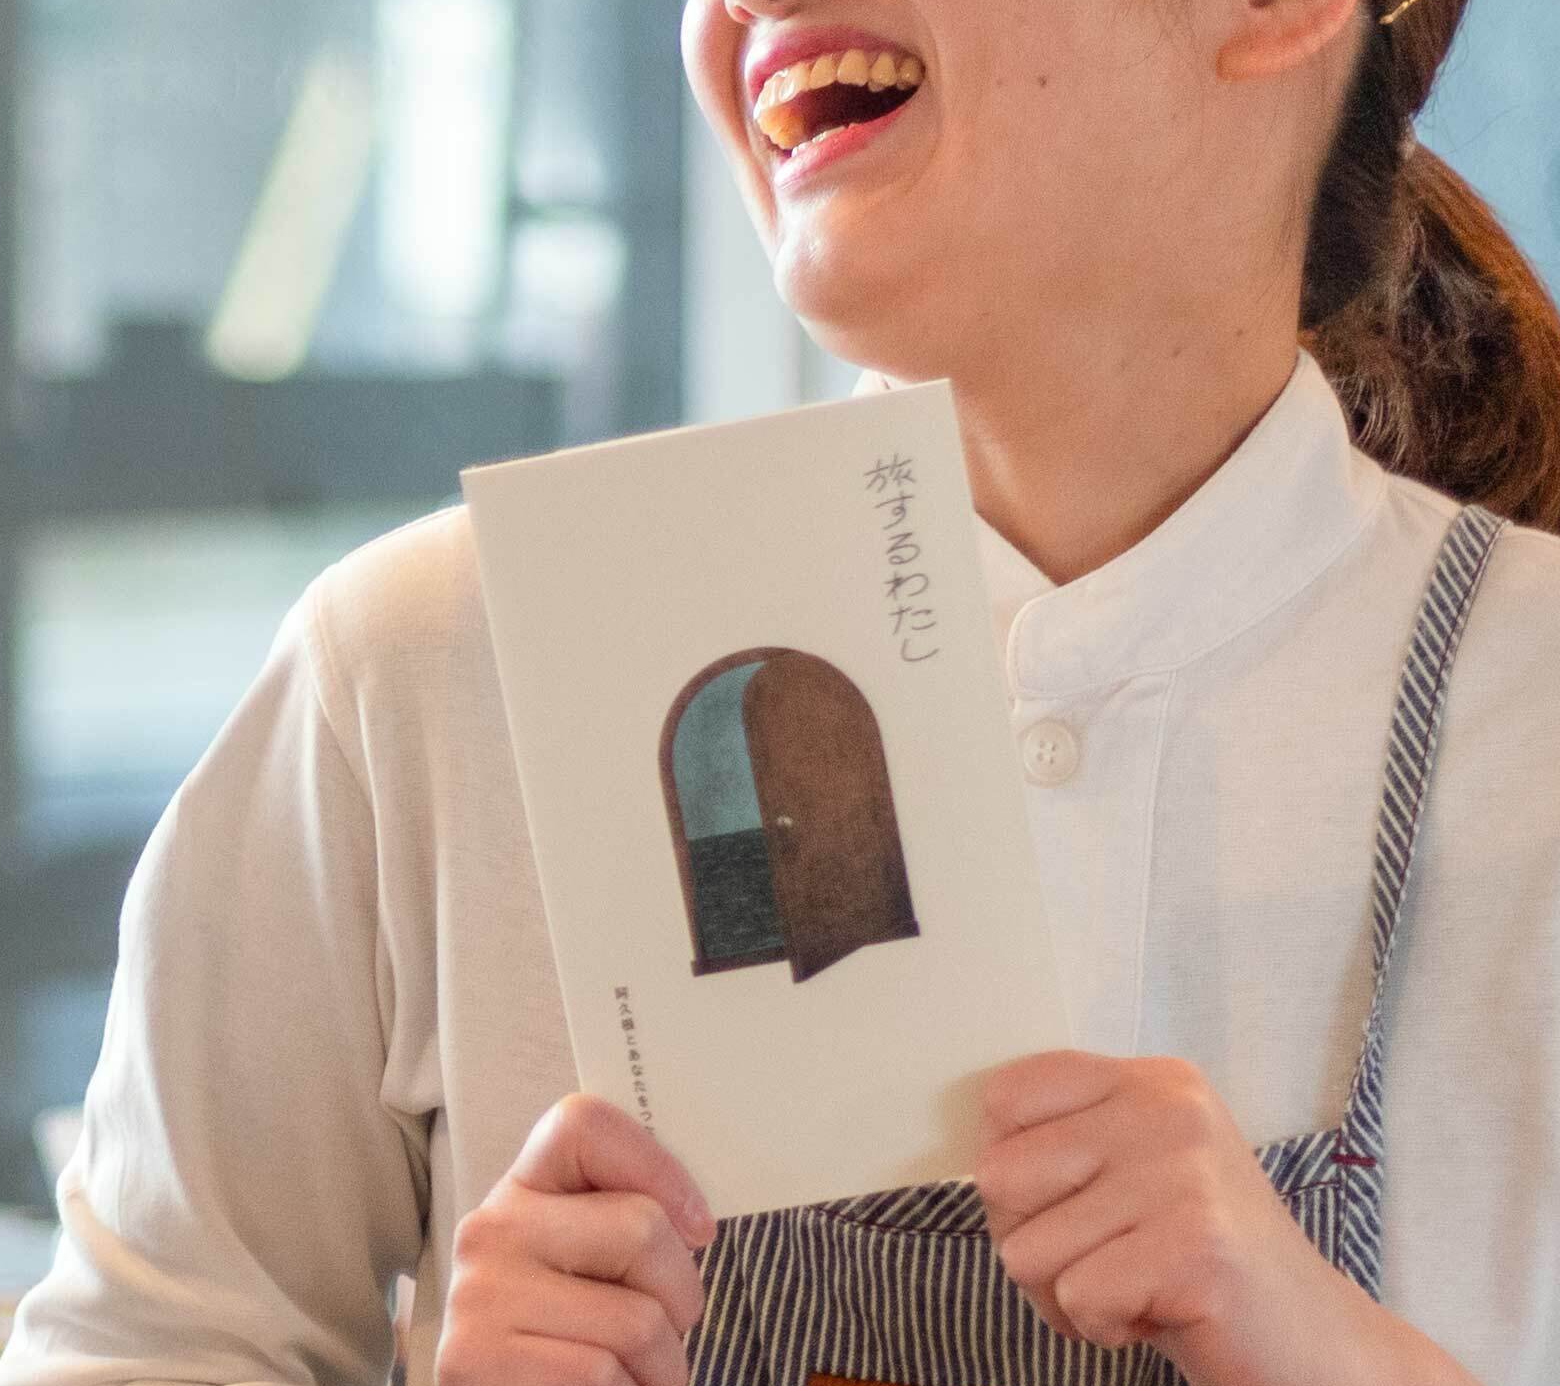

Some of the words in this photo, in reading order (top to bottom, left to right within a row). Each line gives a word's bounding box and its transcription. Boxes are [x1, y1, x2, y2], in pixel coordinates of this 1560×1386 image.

[864, 453, 940, 662] 旅するわたし
